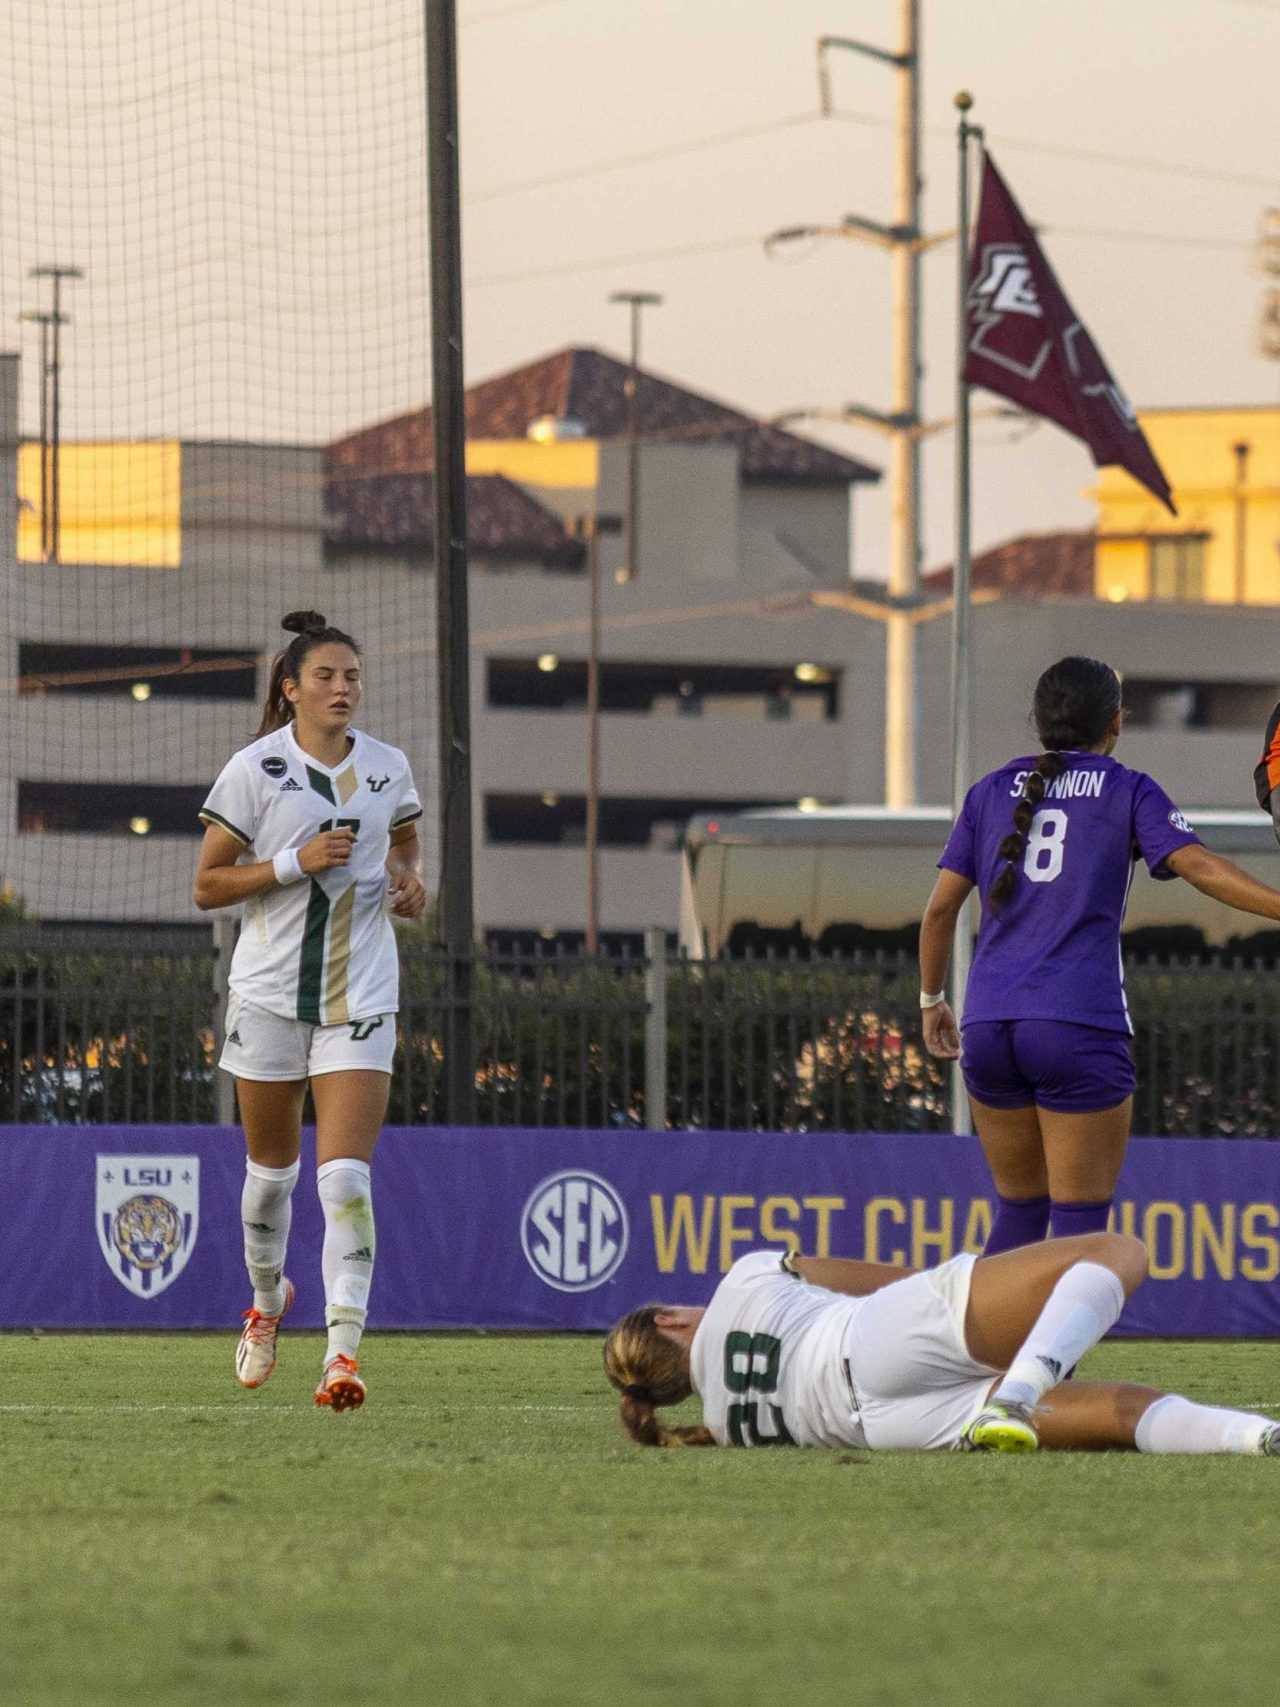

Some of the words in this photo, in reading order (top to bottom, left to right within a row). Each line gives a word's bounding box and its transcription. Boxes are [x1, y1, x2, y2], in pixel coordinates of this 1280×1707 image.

[1023, 809, 1068, 882] 8
[124, 1168, 172, 1186] LSU
[531, 1181, 619, 1281] SEC
[650, 1195, 845, 1274] WEST
[723, 1330, 799, 1448] 28
